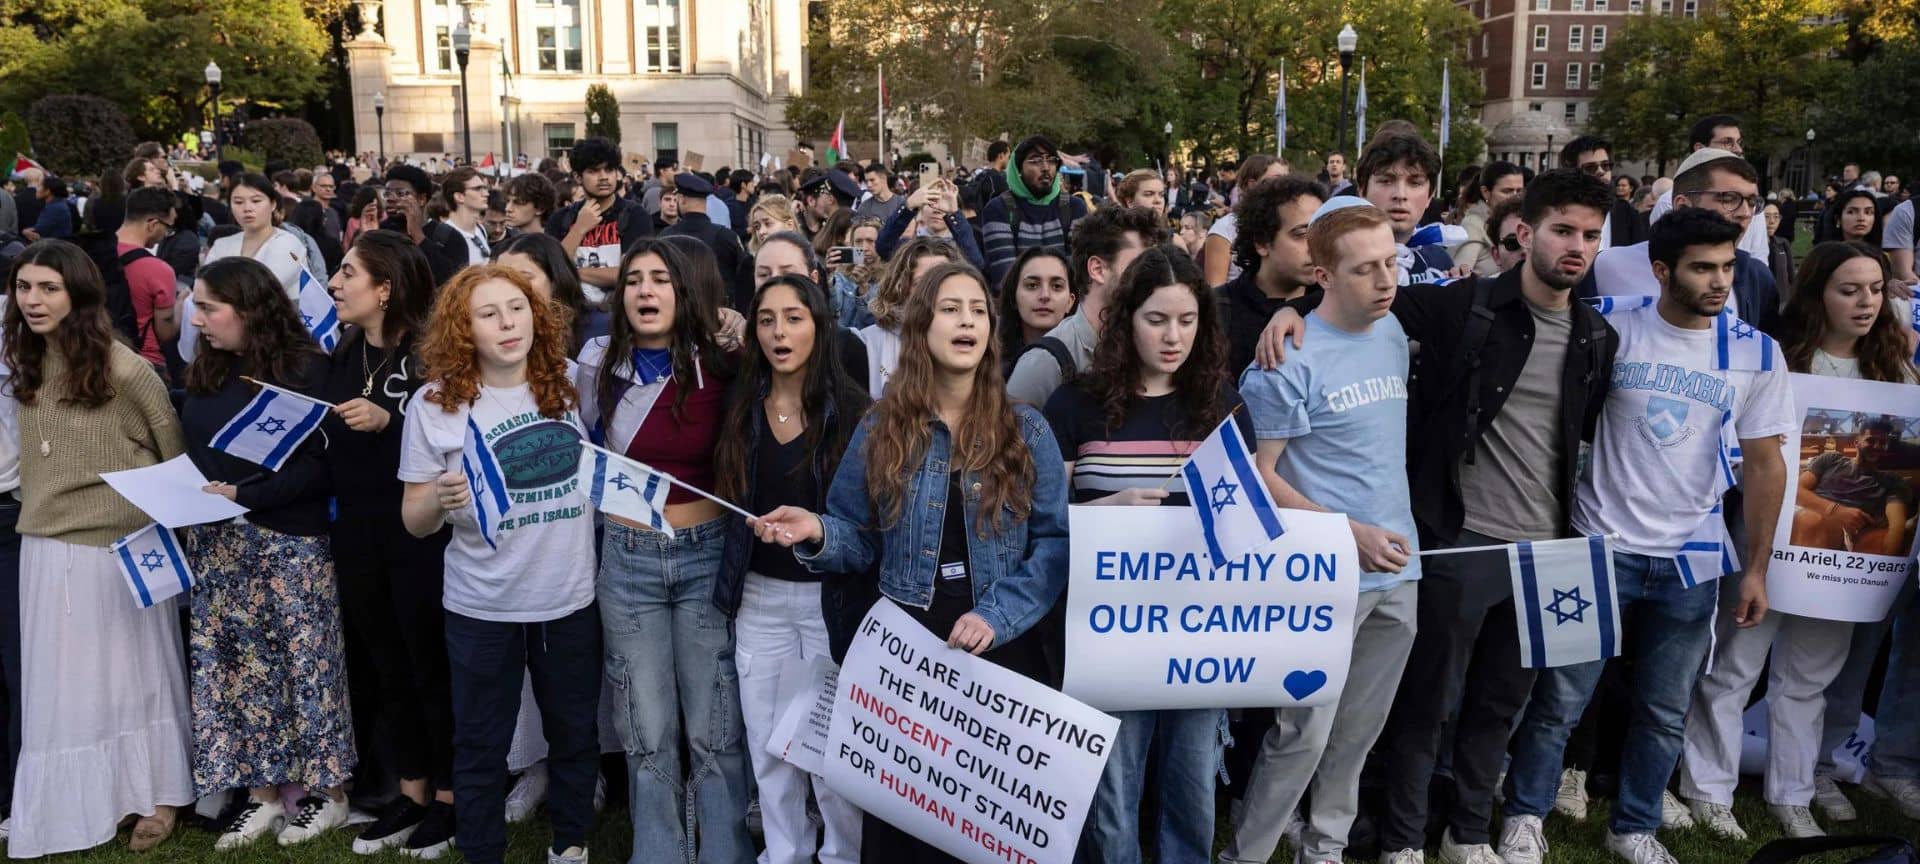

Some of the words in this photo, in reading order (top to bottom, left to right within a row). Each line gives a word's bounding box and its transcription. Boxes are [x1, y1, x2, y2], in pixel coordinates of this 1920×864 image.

[1610, 362, 1736, 412] COLUMBIA
[508, 478, 579, 503] SEMINARS
[518, 511, 540, 528] DIG
[1285, 553, 1337, 582] ON
[1798, 551, 1842, 570] Ariel,
[1846, 556, 1865, 570] 22
[1867, 560, 1906, 574] years
[1807, 571, 1820, 580] We
[1822, 574, 1841, 583] miss
[1843, 576, 1859, 584] you
[1861, 578, 1889, 587] Danush
[1089, 604, 1168, 633] OUR
[1180, 604, 1334, 633] CAMPUS
[1166, 657, 1256, 684] NOW
[862, 616, 880, 637] IF
[879, 630, 916, 664] YOU
[916, 656, 961, 690] ARE
[962, 681, 1107, 757] JUSTIFYING
[879, 666, 916, 702] THE
[920, 690, 1011, 756] MURDER
[1016, 744, 1050, 771] OF
[849, 684, 953, 757] INNOCENT
[955, 748, 1068, 821] CIVILIANS
[839, 743, 877, 778] FOR
[879, 768, 956, 828] HUMAN
[851, 716, 889, 753] YOU
[893, 744, 922, 775] DO
[926, 765, 973, 803] NOT
[974, 794, 1050, 849] STAND
